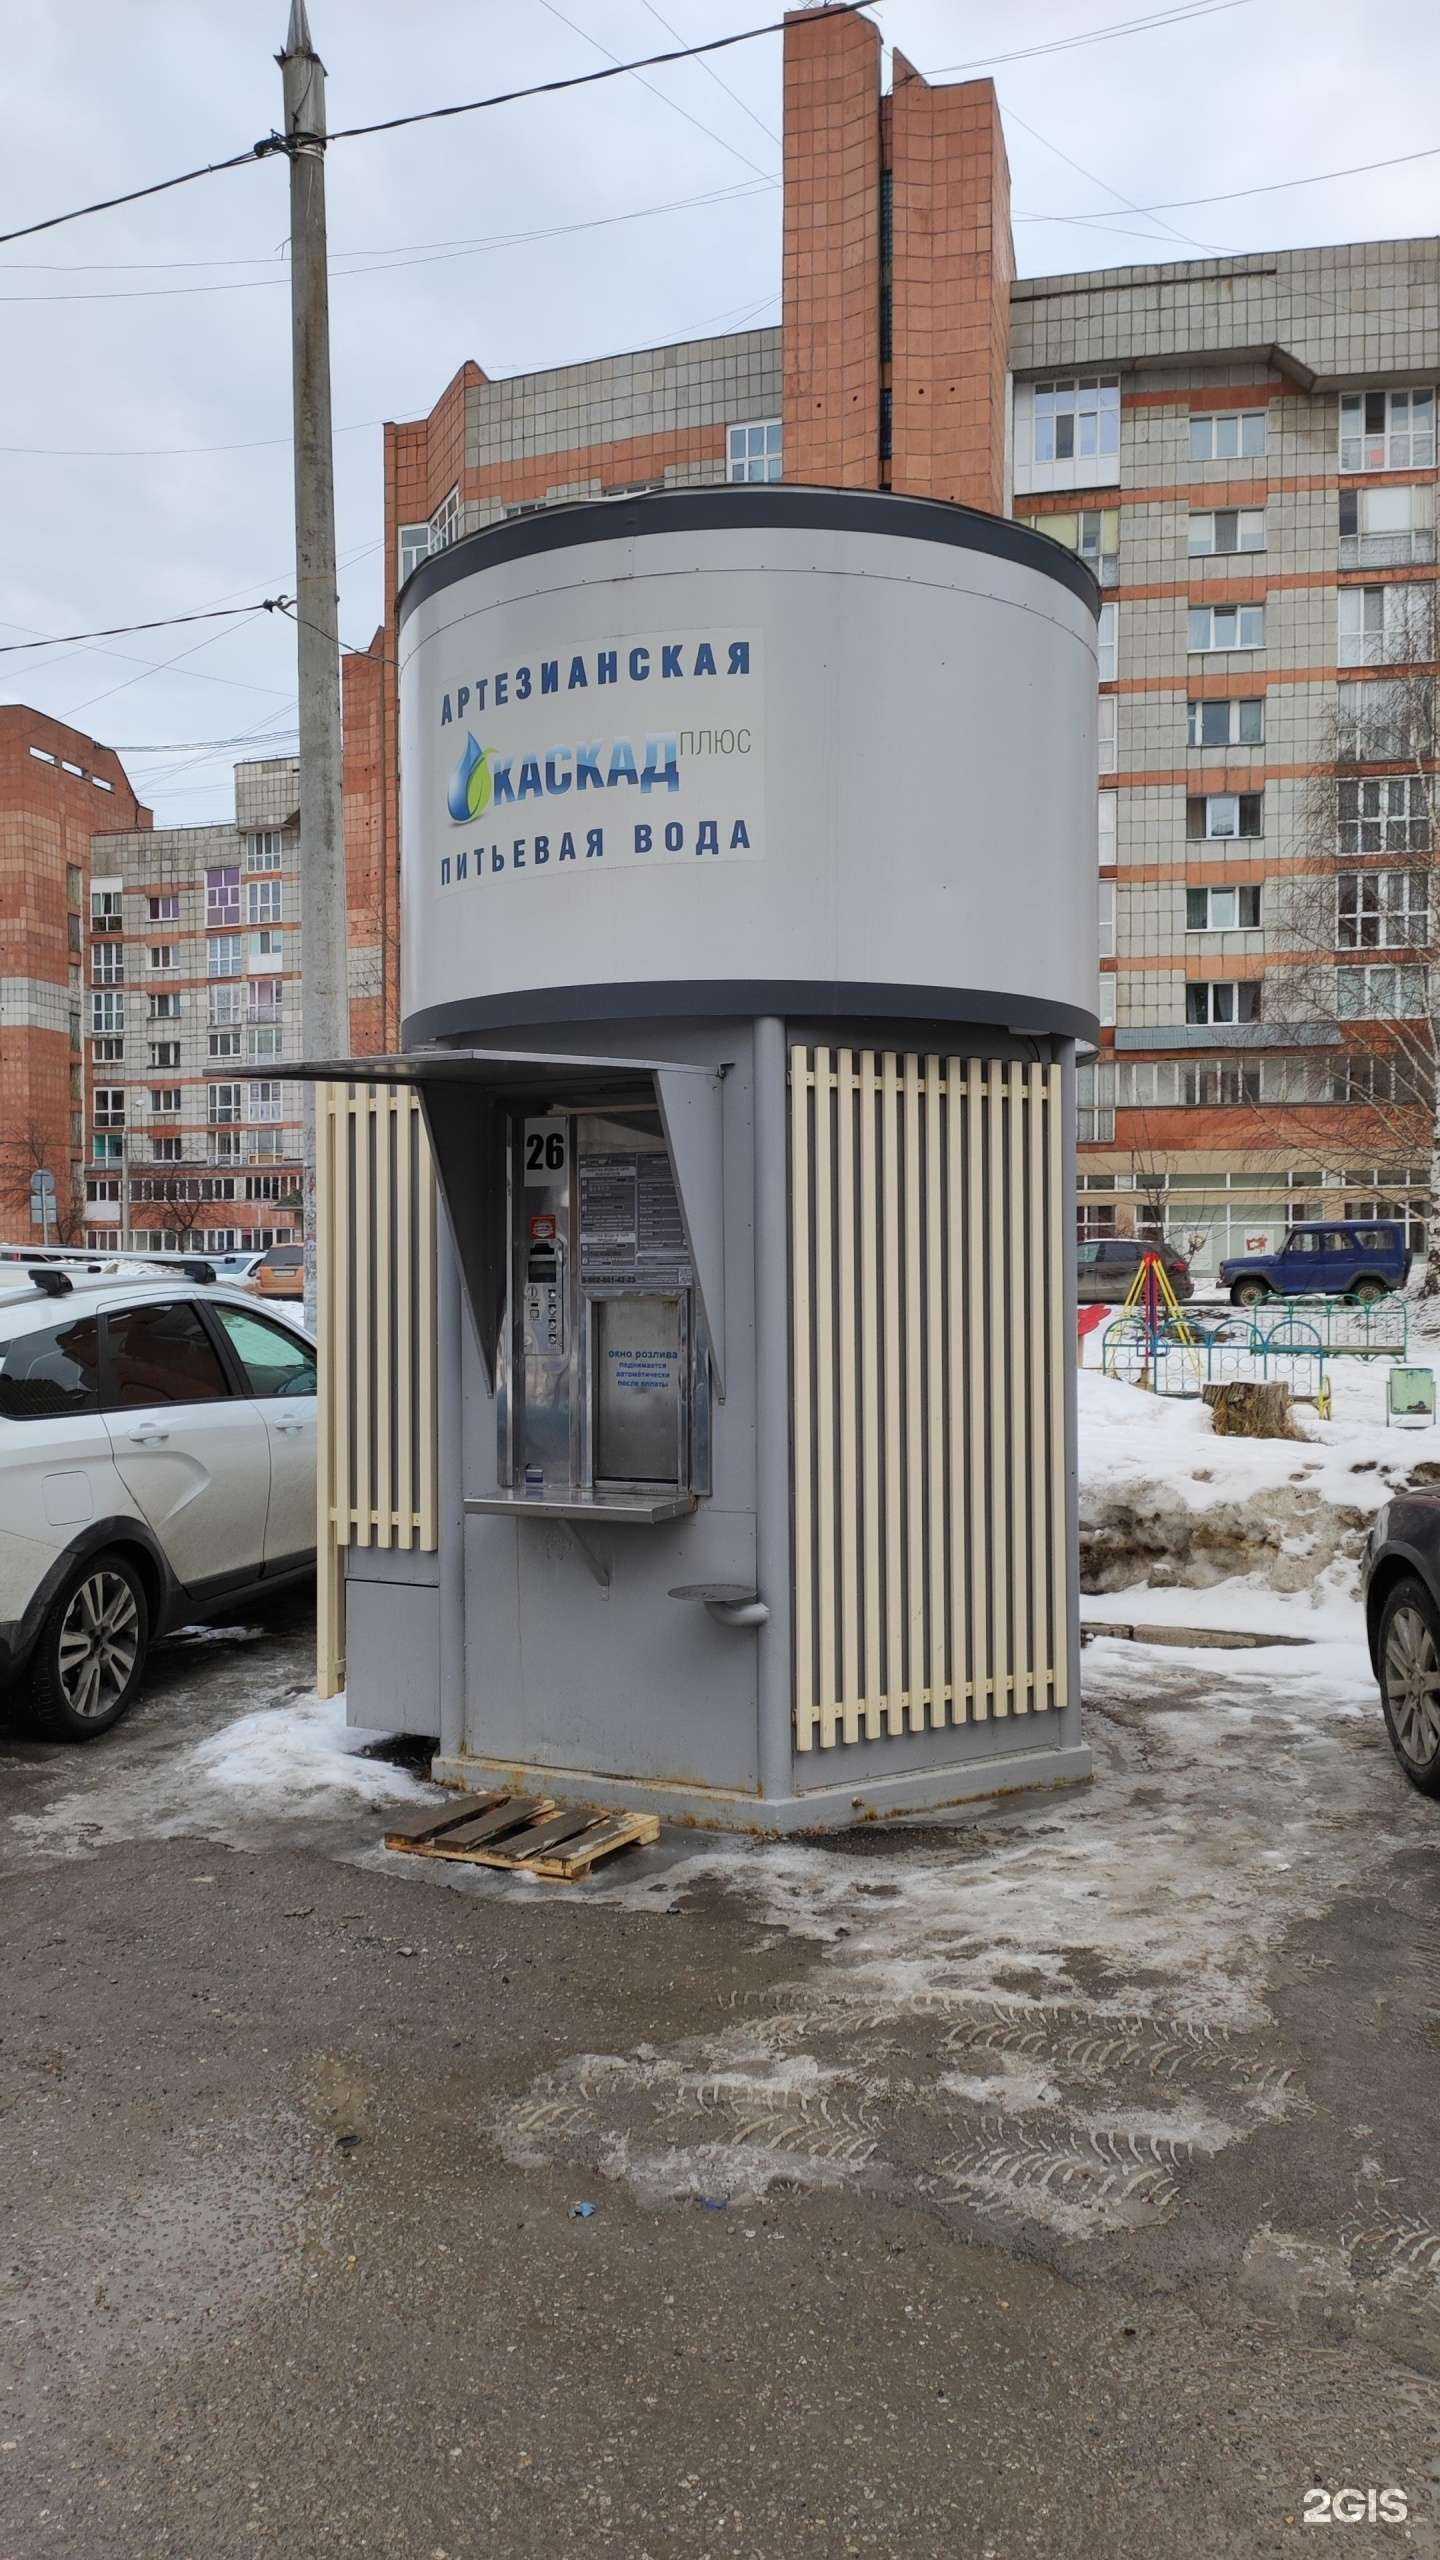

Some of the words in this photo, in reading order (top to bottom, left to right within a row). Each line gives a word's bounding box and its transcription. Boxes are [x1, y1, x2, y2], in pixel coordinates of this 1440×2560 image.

[441, 642, 750, 726] АРТЕЗИАНСКАЯ
[493, 732, 680, 806] КАСКАД
[680, 728, 751, 756] ПЛЮС
[441, 828, 603, 886] ПИТЬЕВАЯ
[634, 820, 750, 855] ВОДА
[526, 1133, 565, 1170] 26
